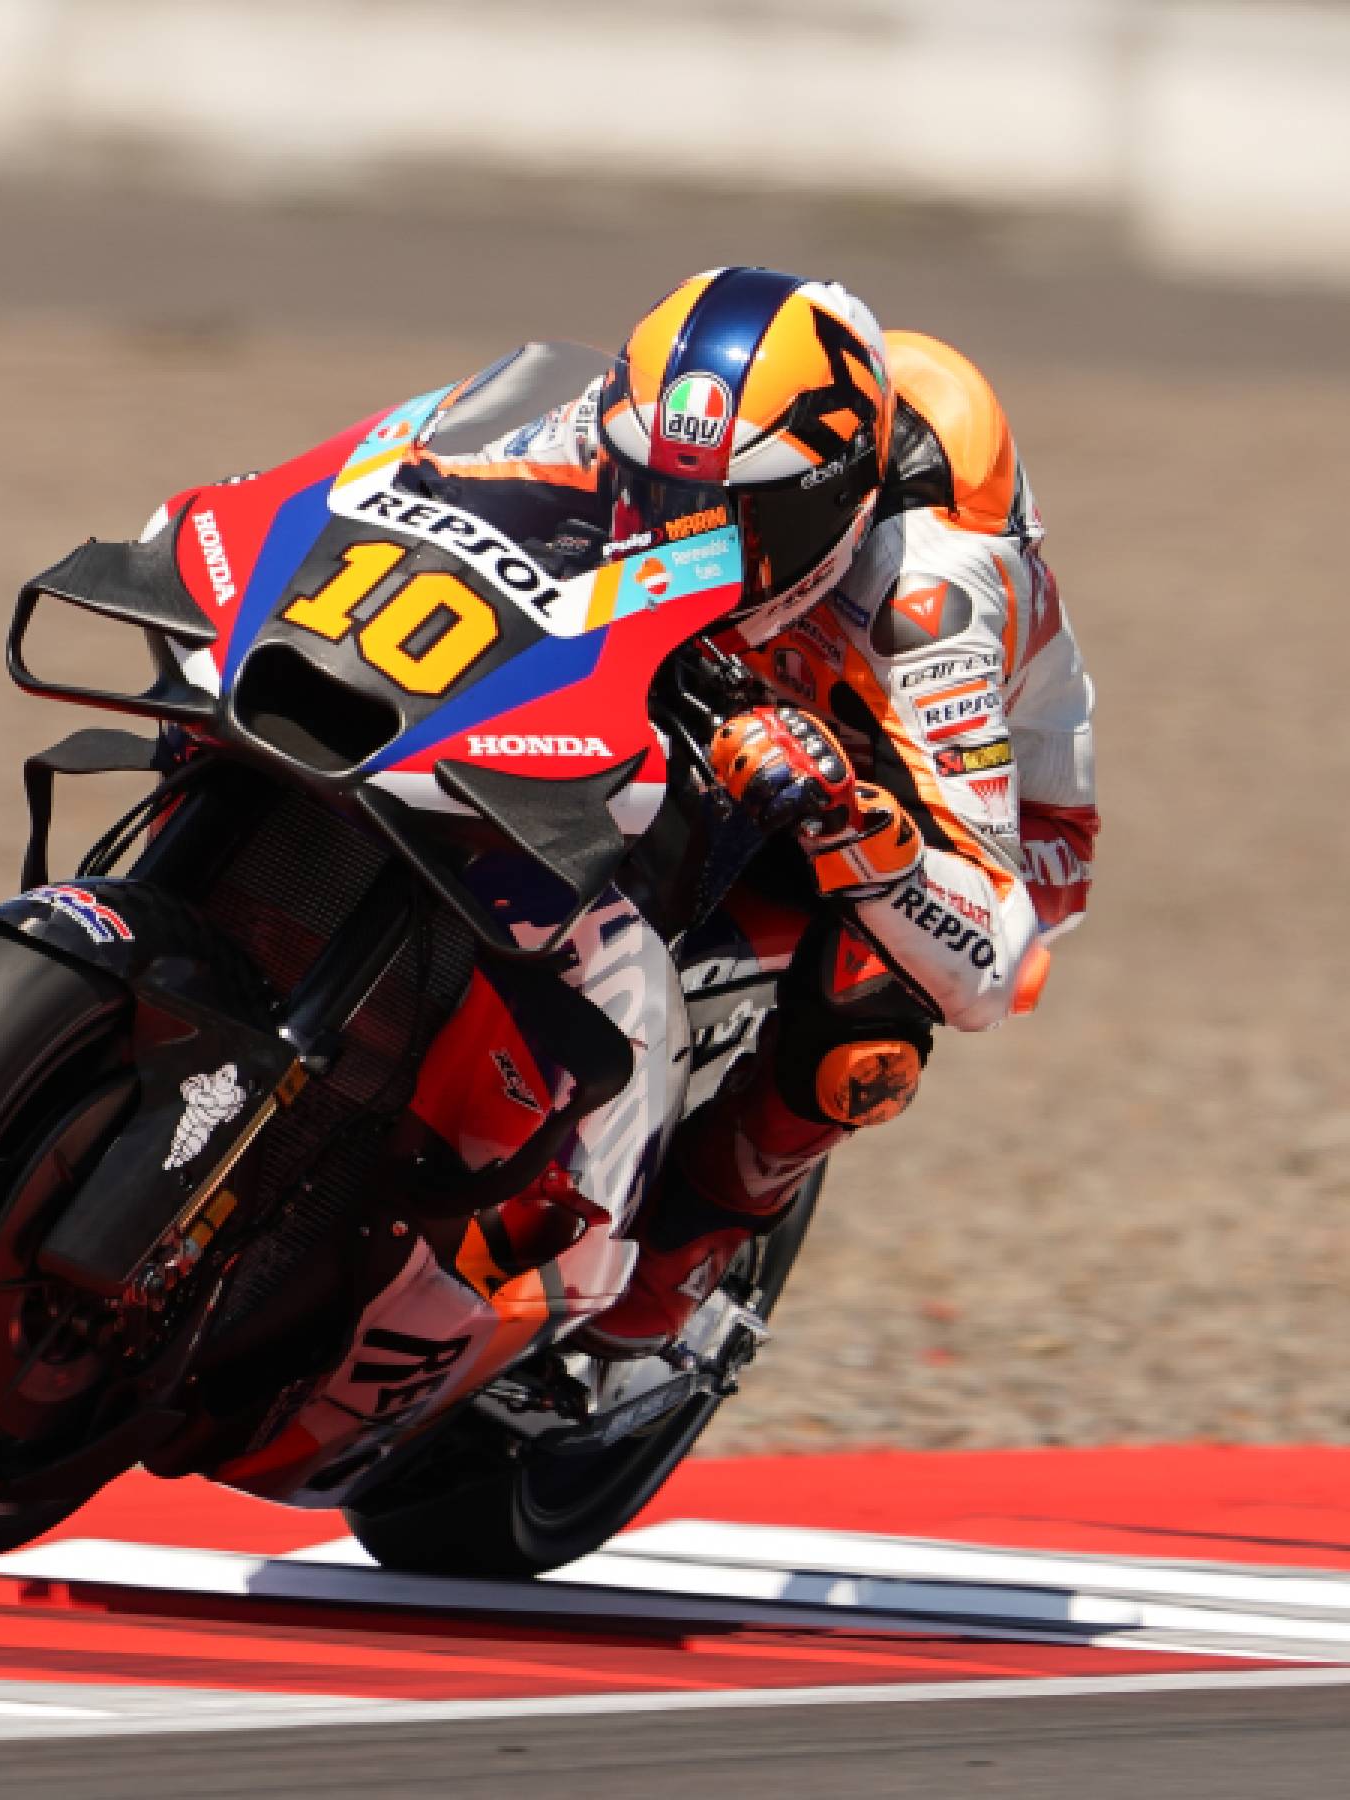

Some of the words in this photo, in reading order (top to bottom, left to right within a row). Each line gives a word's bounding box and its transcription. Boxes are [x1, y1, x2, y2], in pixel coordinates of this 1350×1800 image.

[665, 411, 720, 443] agv
[191, 509, 237, 606] HONDA
[356, 491, 564, 619] REPSOL
[281, 540, 500, 699] 10
[467, 734, 614, 758] HONDA
